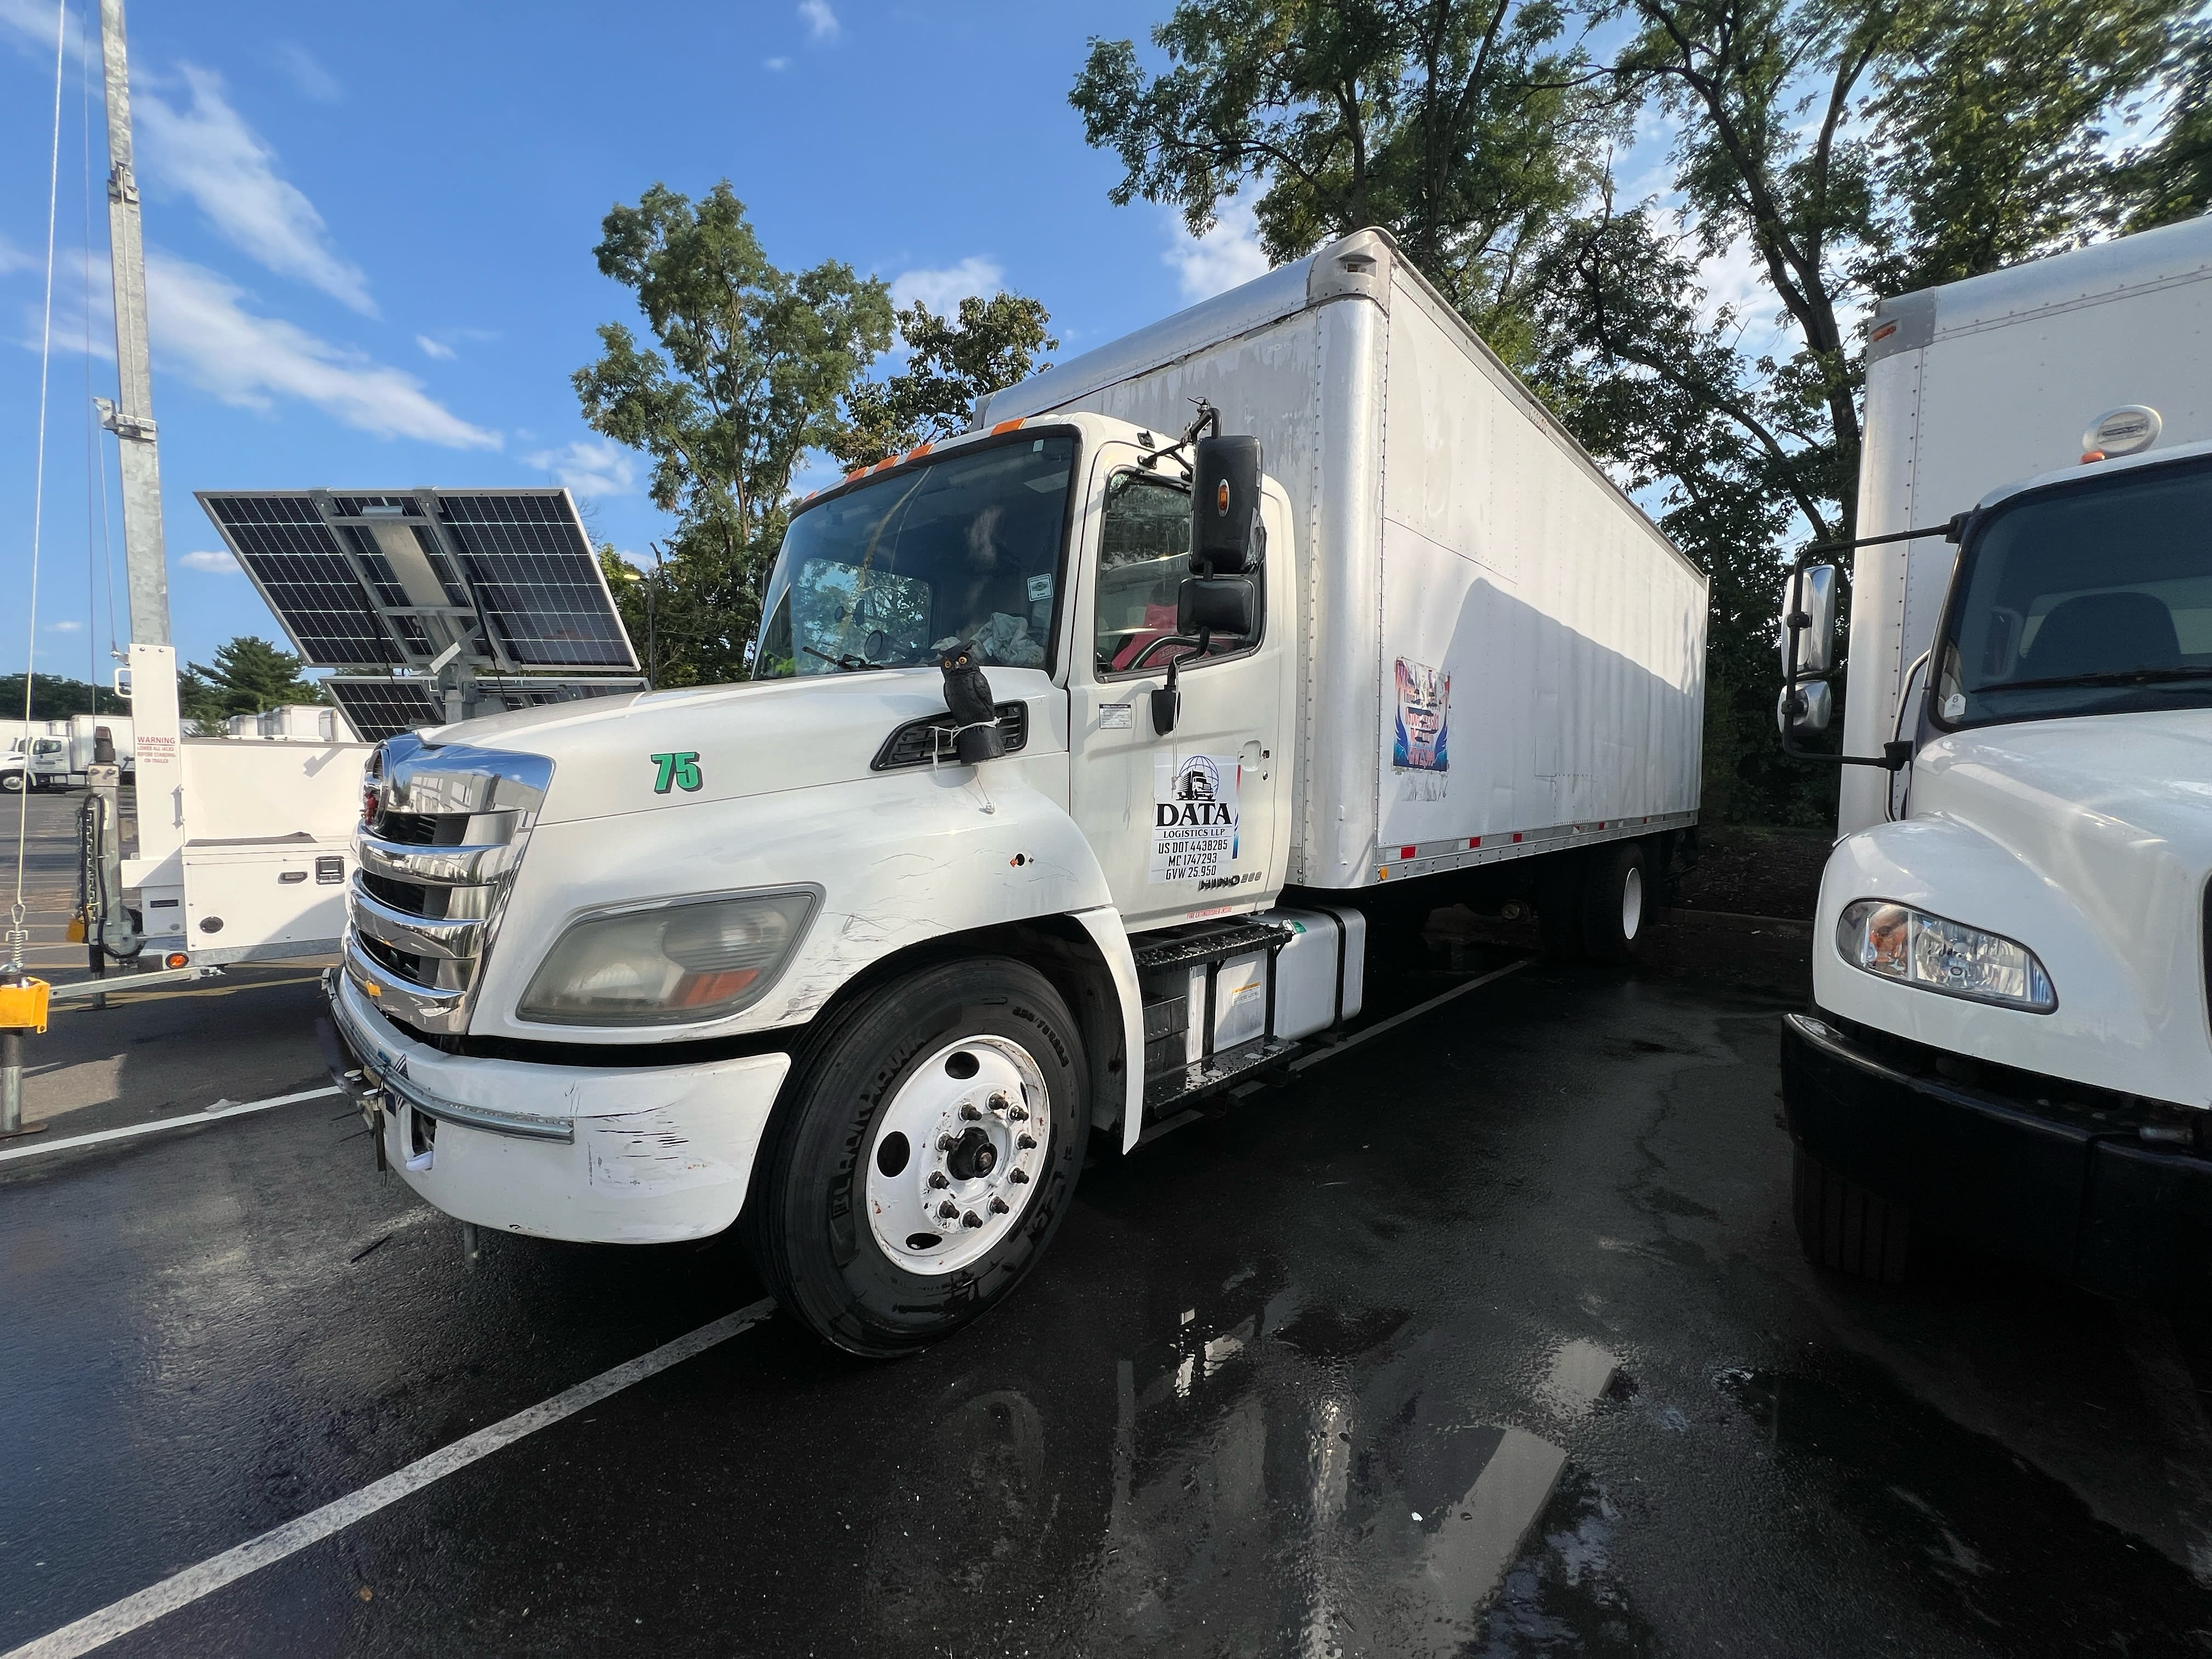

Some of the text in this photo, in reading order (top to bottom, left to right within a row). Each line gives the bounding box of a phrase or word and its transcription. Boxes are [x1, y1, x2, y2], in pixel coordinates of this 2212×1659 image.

[651, 752, 703, 794] 75
[1155, 803, 1233, 827] DATA
[1163, 830, 1208, 838] LOGISTICS
[1158, 839, 1228, 854] US DOT 4438285
[1168, 853, 1217, 867] MC 1747293
[1166, 865, 1217, 880] GVW 25.950
[1198, 874, 1240, 890] HINO
